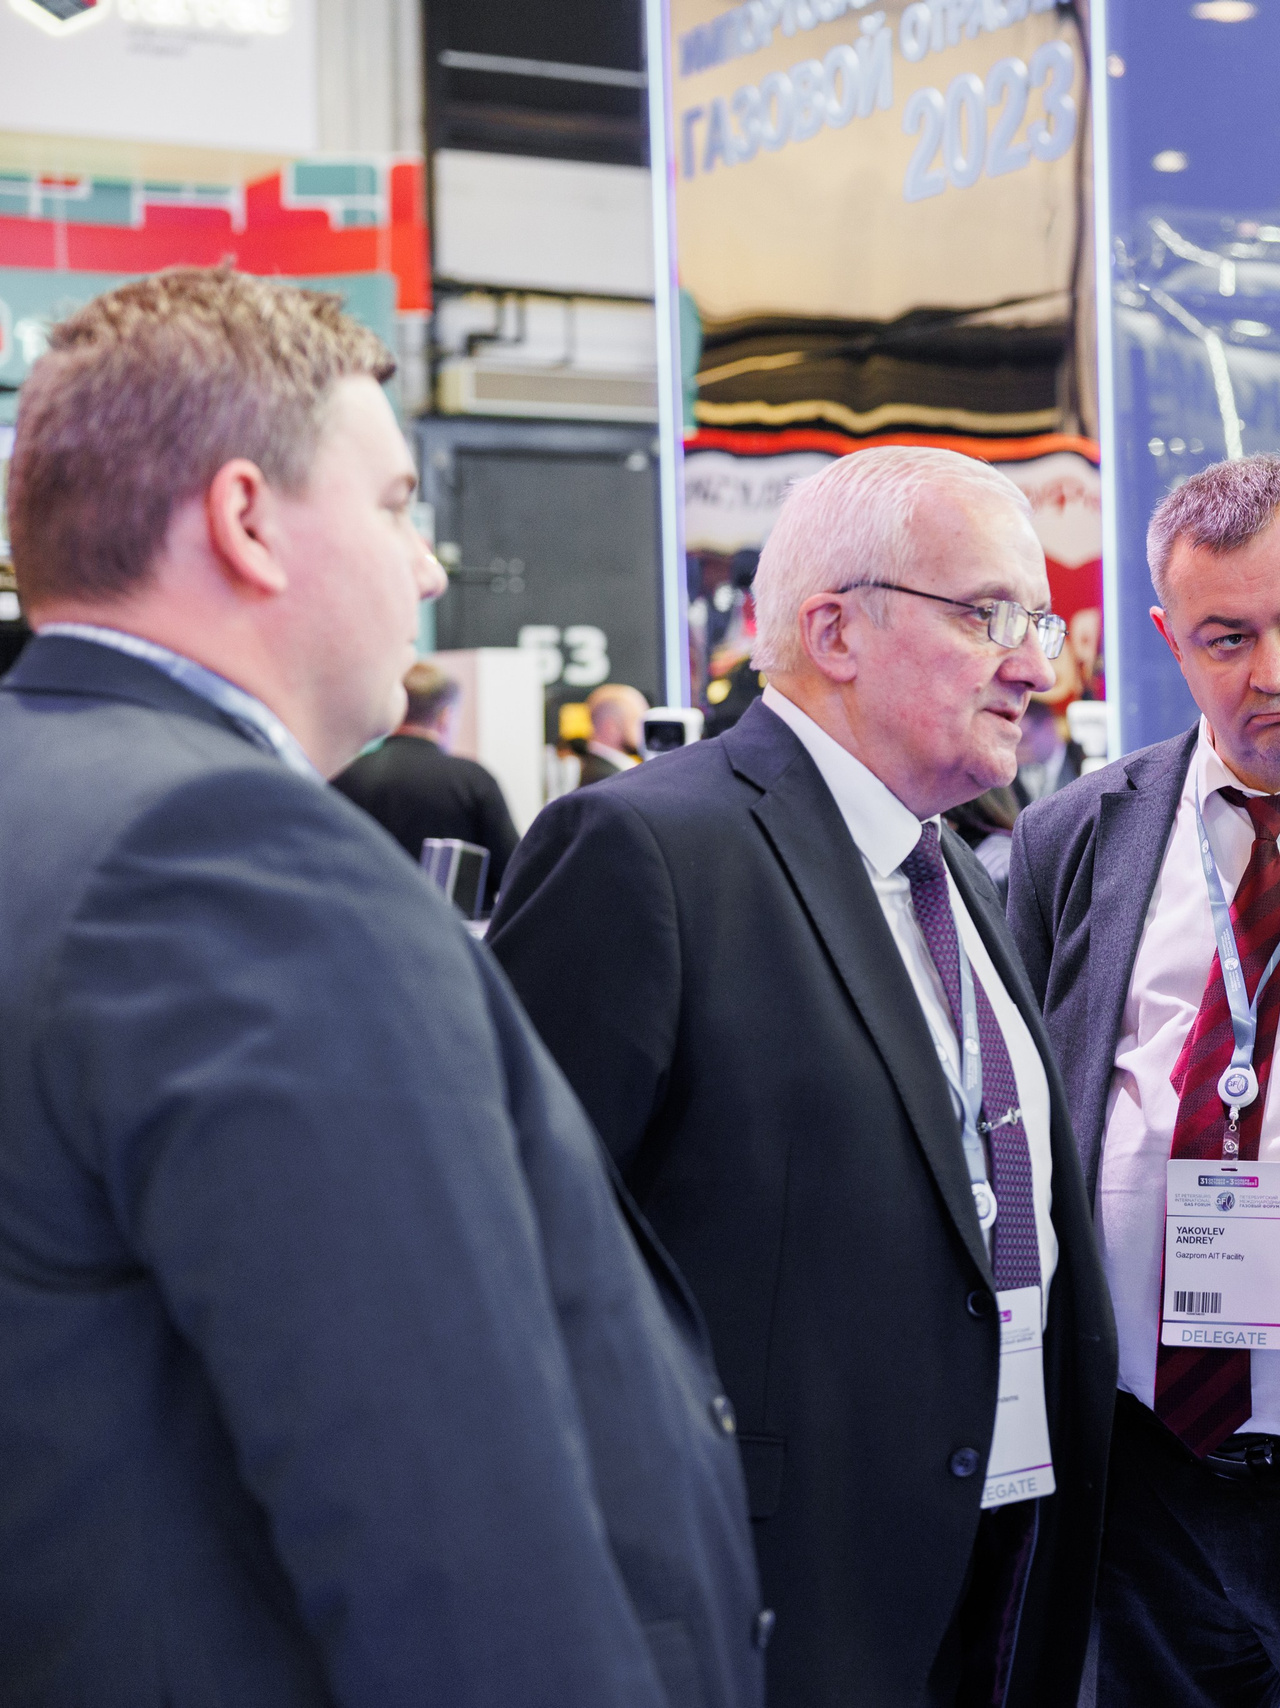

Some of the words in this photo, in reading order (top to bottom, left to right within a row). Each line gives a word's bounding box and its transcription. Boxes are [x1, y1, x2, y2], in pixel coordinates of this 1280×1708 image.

[681, 10, 894, 181] ГАЗОВОЙ
[902, 39, 1078, 203] 2023
[1176, 1226, 1225, 1236] YAKOVLEV
[1175, 1235, 1214, 1245] ANDREY
[1175, 1251, 1207, 1260] Gazprom
[1221, 1252, 1245, 1261] Facility
[1181, 1329, 1267, 1346] DELEGATE
[984, 1477, 1038, 1501] EGATE
